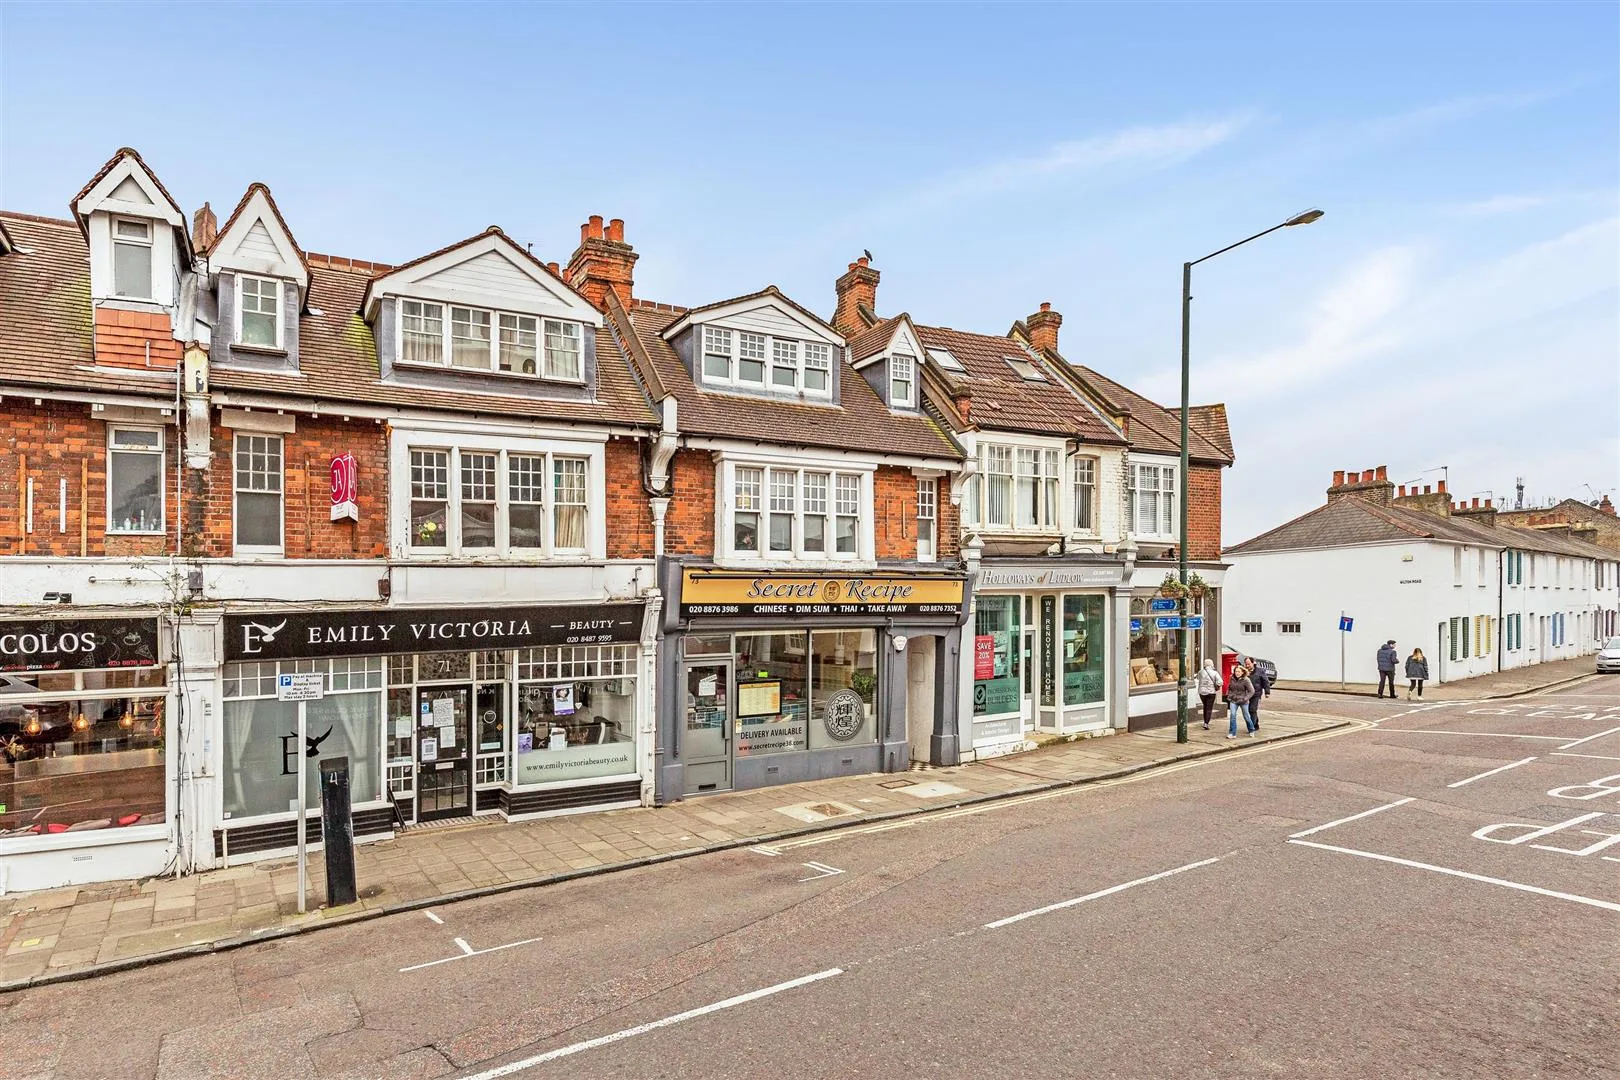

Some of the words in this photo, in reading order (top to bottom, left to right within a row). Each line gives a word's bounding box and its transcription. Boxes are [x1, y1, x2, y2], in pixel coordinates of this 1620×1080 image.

[1037, 571, 1048, 585] of
[1048, 570, 1083, 584] LUDLOW
[746, 578, 818, 598] Secret
[843, 578, 914, 602] Recipe
[688, 605, 702, 613] 020
[703, 605, 721, 613] 8876
[721, 605, 739, 613] 3986
[753, 605, 788, 613] CHINESE
[795, 605, 811, 613] DIM
[812, 605, 830, 613] SUM
[840, 605, 858, 613] THAI
[867, 604, 885, 613] TAKE
[887, 604, 907, 613] AWAY
[1045, 601, 1051, 613] WE
[569, 619, 615, 630] BEAUTY
[307, 624, 396, 644] EMILY
[409, 619, 532, 639] VICTORIA
[567, 635, 579, 643] 020
[580, 634, 597, 643] 8487
[977, 642, 992, 650] SAVE
[978, 651, 990, 659] 20%
[437, 660, 451, 673] 71
[740, 730, 769, 740] DELIVERY
[770, 726, 802, 737] AVAILABLE
[526, 755, 629, 772] www.emilyvictoriabeauty.co.uk
